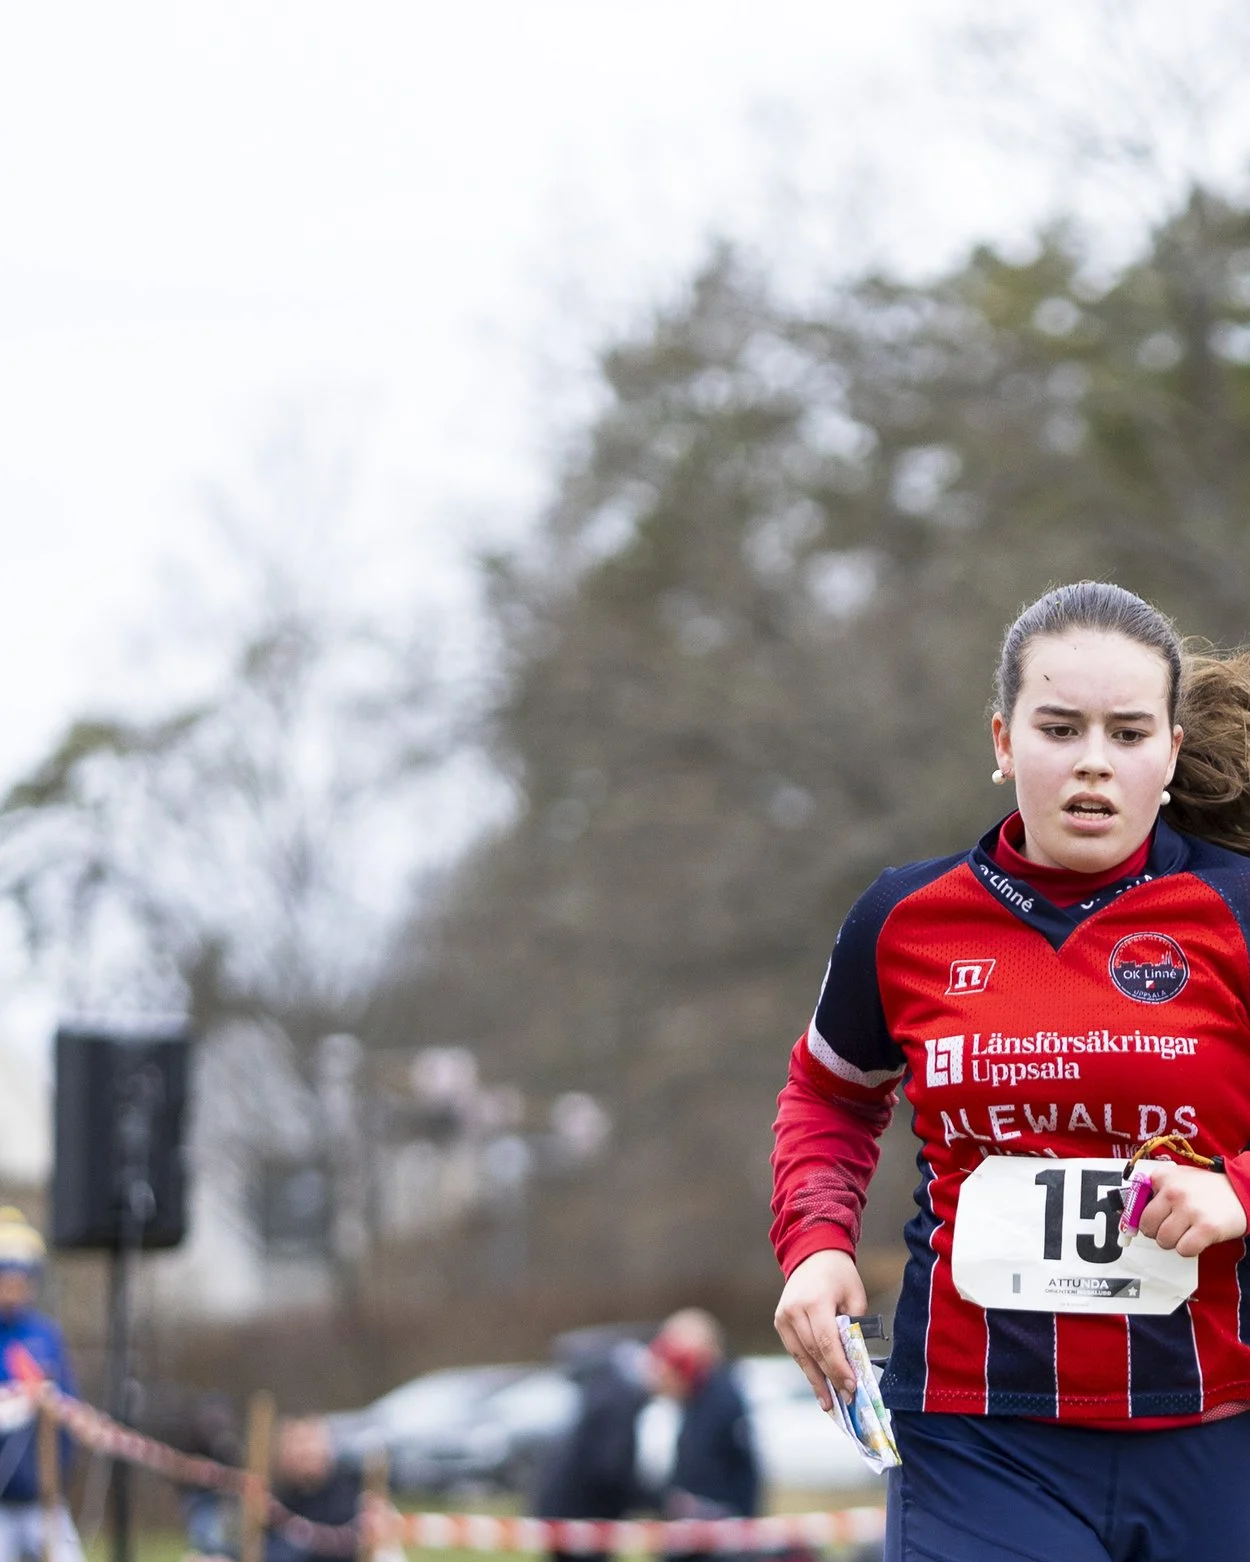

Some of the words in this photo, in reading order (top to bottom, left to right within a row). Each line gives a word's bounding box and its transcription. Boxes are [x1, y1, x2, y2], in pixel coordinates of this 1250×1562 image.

[1123, 969, 1141, 980] OK
[1144, 968, 1177, 980] Linné
[971, 1030, 1199, 1060] Länsförsäkringar
[971, 1057, 1080, 1087] Uppsala
[940, 1102, 1199, 1148] ALEWALDS
[1035, 1168, 1123, 1264] 15
[1048, 1278, 1109, 1290] ATTUNDA
